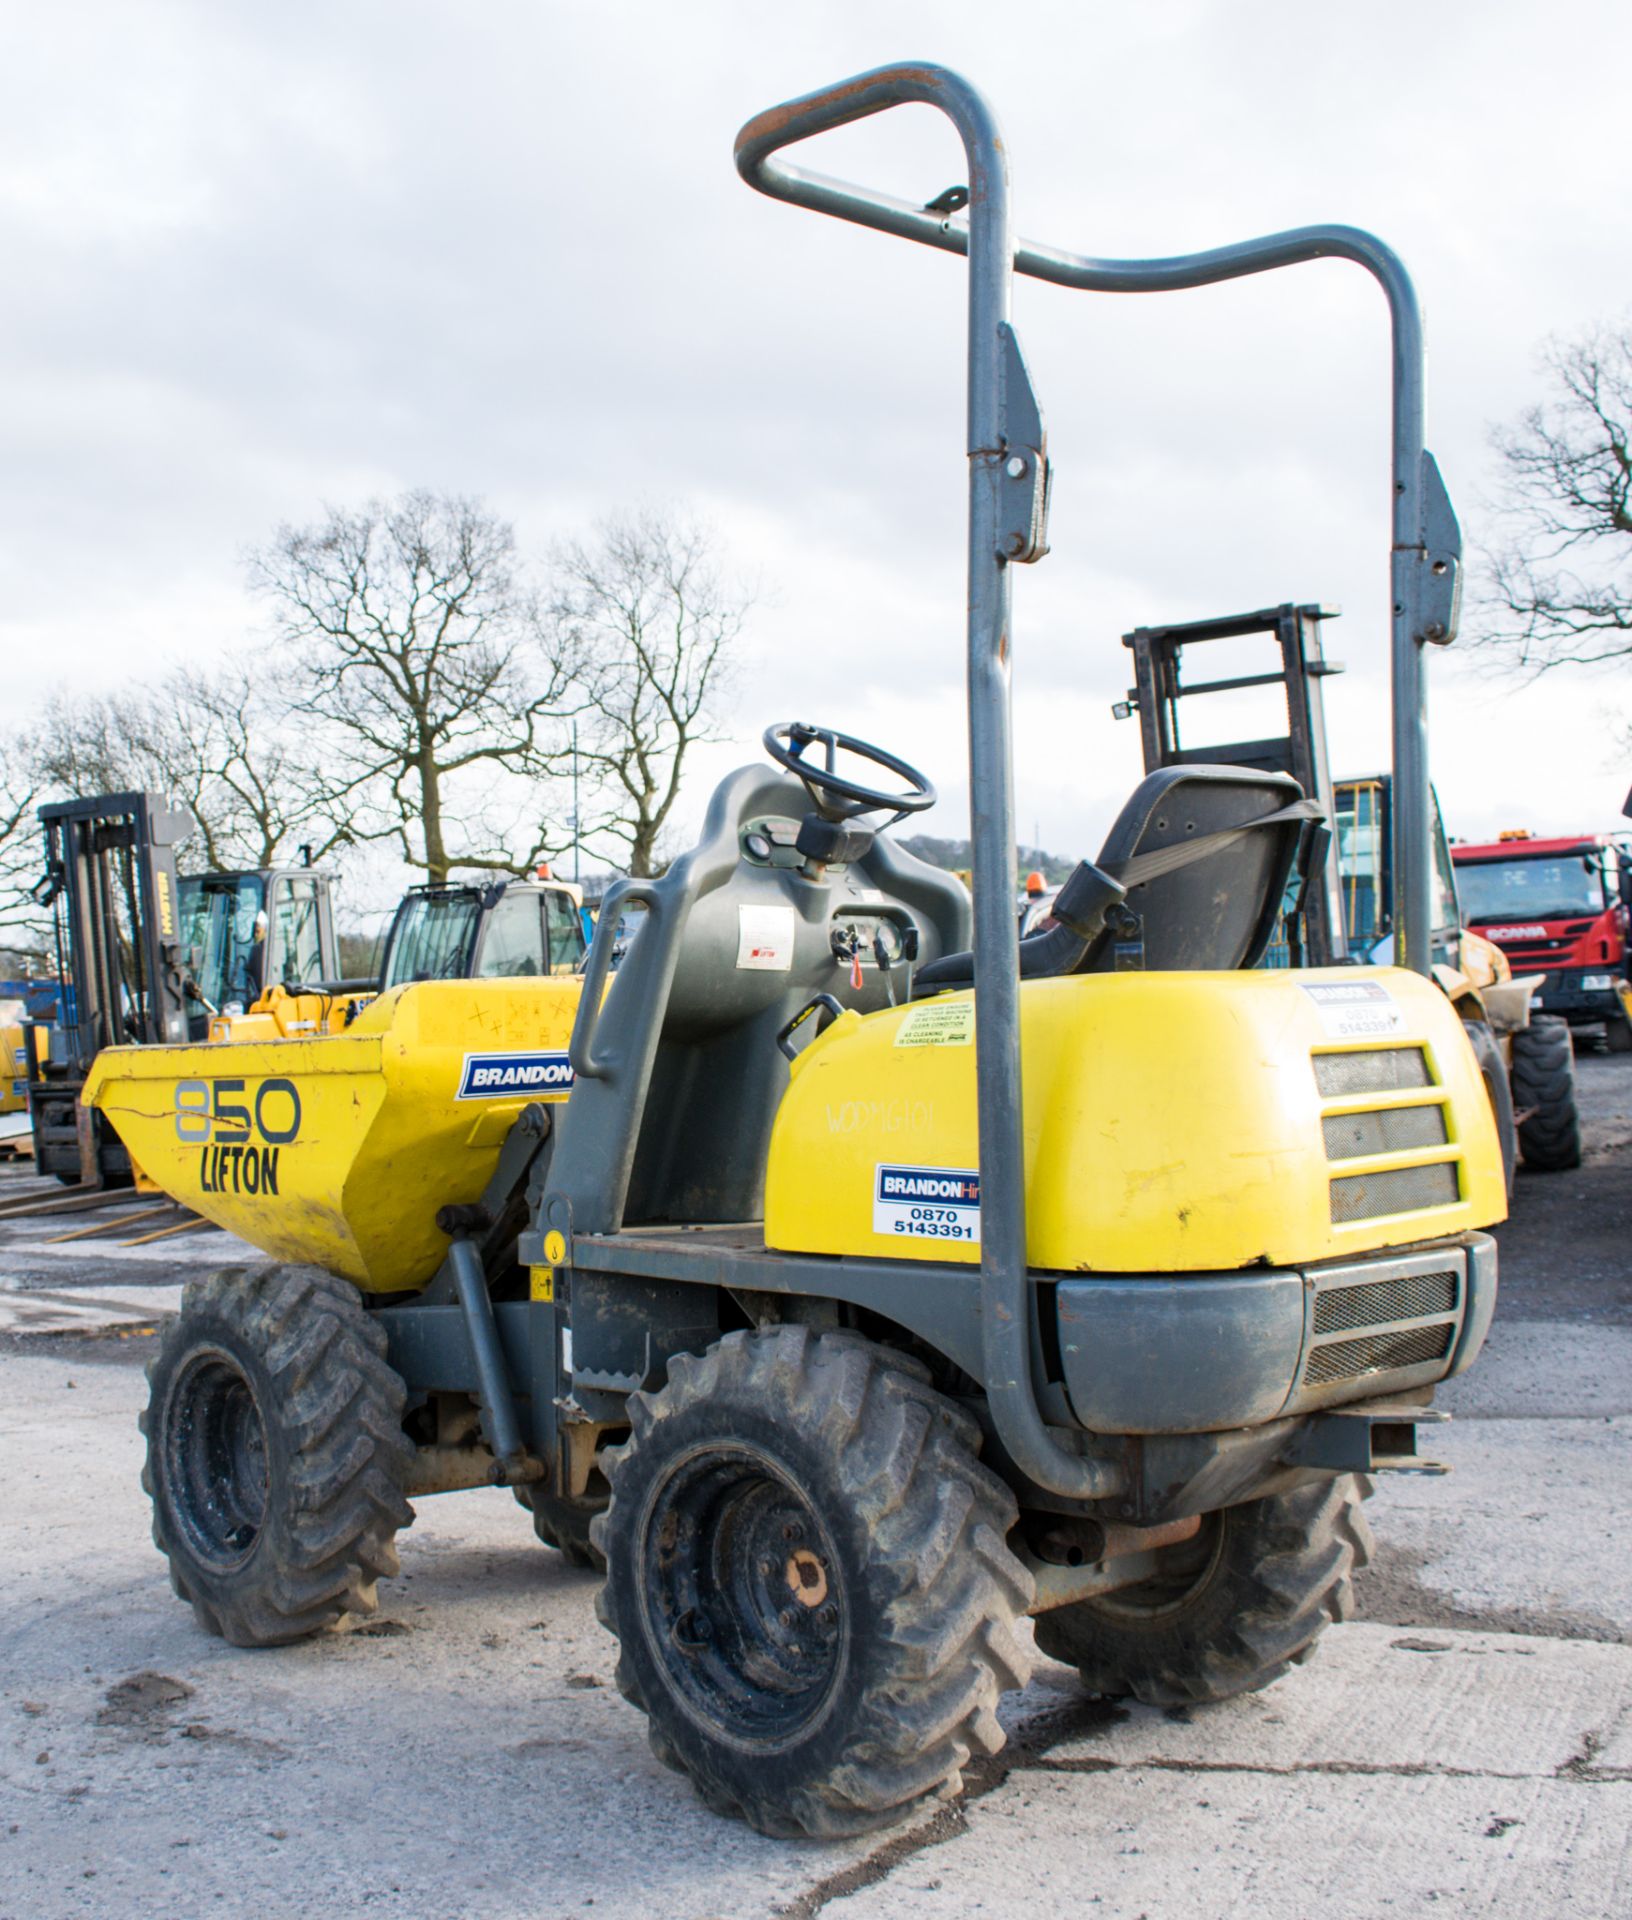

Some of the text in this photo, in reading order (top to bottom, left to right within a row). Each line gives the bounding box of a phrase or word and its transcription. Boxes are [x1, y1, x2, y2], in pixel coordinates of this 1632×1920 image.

[157, 871, 173, 935] HYSTER
[1486, 926, 1547, 940] SCANIA
[1339, 1020, 1394, 1035] 5143391
[472, 1065, 576, 1086] BRANDON
[174, 1079, 302, 1144] 850
[200, 1146, 279, 1195] LIFTON
[911, 1208, 957, 1223] 0870
[894, 1221, 972, 1238] 5143391
